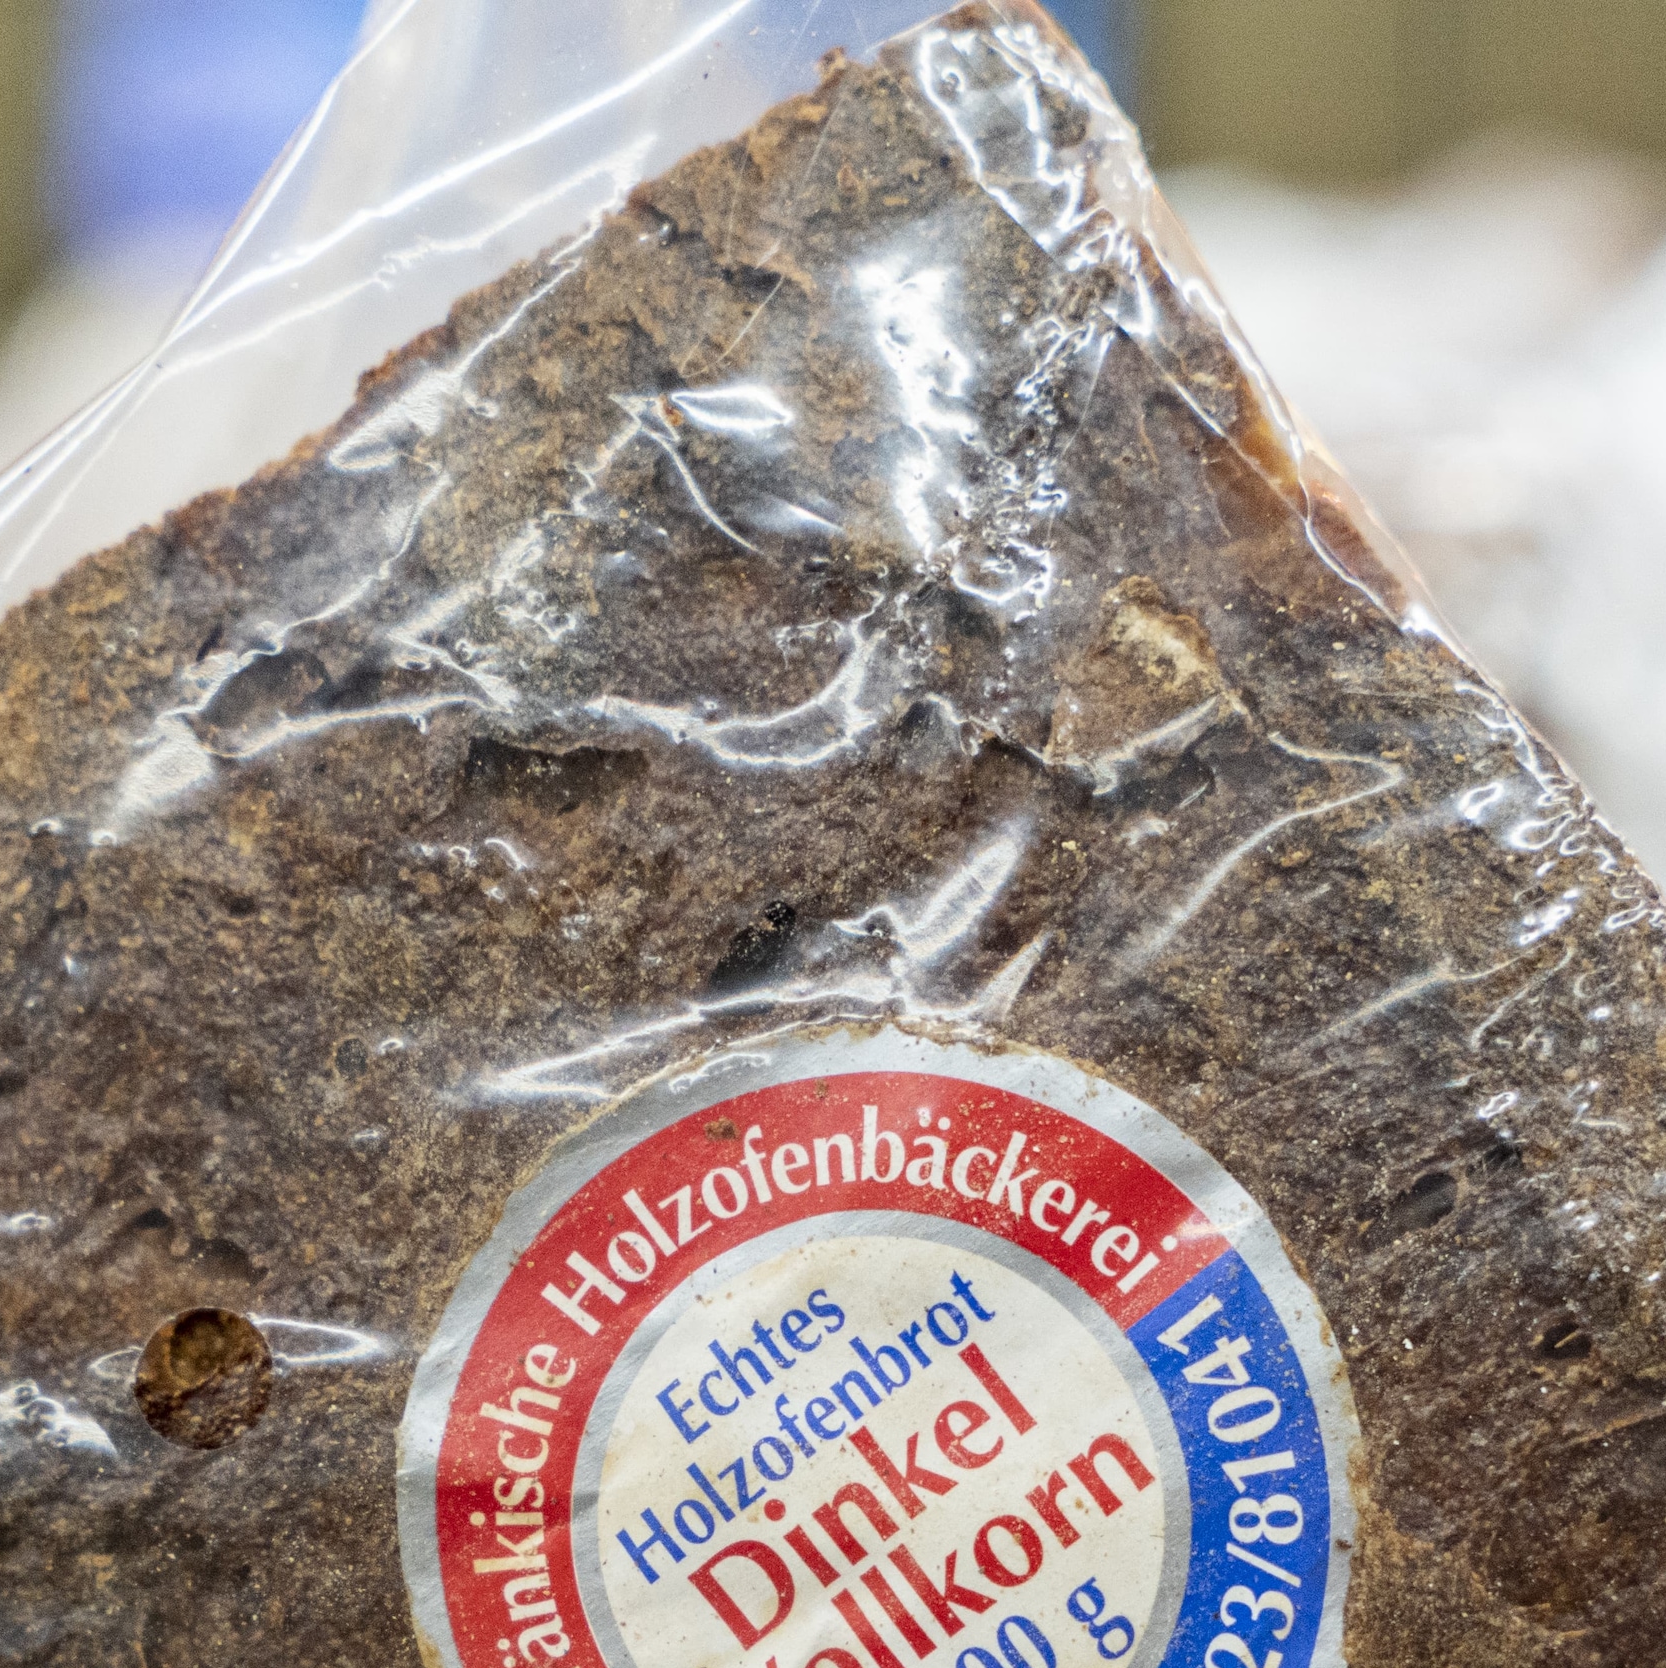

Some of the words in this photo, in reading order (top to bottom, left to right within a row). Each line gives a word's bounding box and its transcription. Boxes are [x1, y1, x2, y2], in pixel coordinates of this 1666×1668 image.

[543, 1104, 1179, 1335] Holzofenbäckerei
[615, 1270, 995, 1585] Holzofenbrot
[655, 1286, 848, 1445] Echtes
[687, 1343, 1037, 1652] Dinkel
[1067, 1578, 1136, 1661] g
